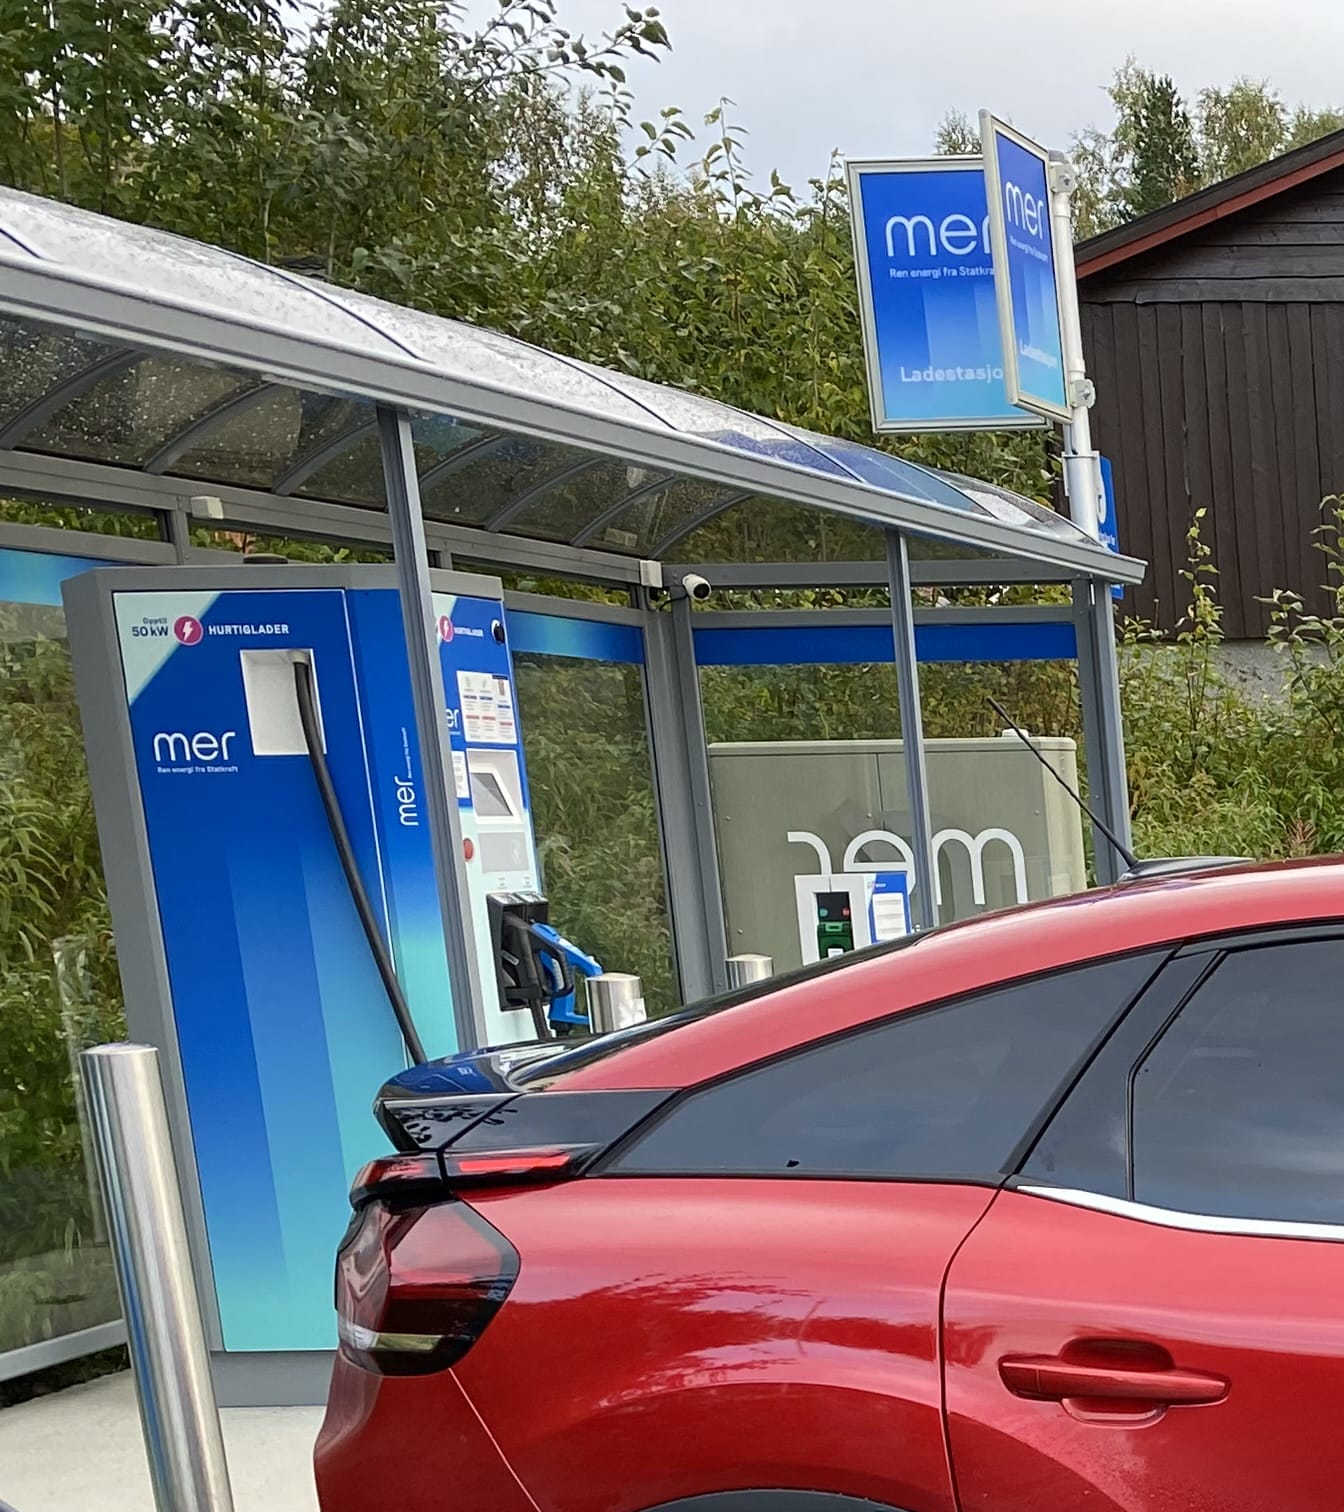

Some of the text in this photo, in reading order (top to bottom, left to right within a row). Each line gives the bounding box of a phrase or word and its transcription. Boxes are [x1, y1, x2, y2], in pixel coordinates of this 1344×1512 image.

[1005, 181, 1044, 240] mer
[885, 214, 992, 257] mer
[890, 266, 995, 279] Ren energi fra Statkra
[900, 364, 1003, 383] Ladestasjo
[132, 626, 169, 636] 50 kW
[208, 624, 290, 635] HURTIGLADER
[153, 731, 236, 761] mer
[394, 775, 419, 826] mer
